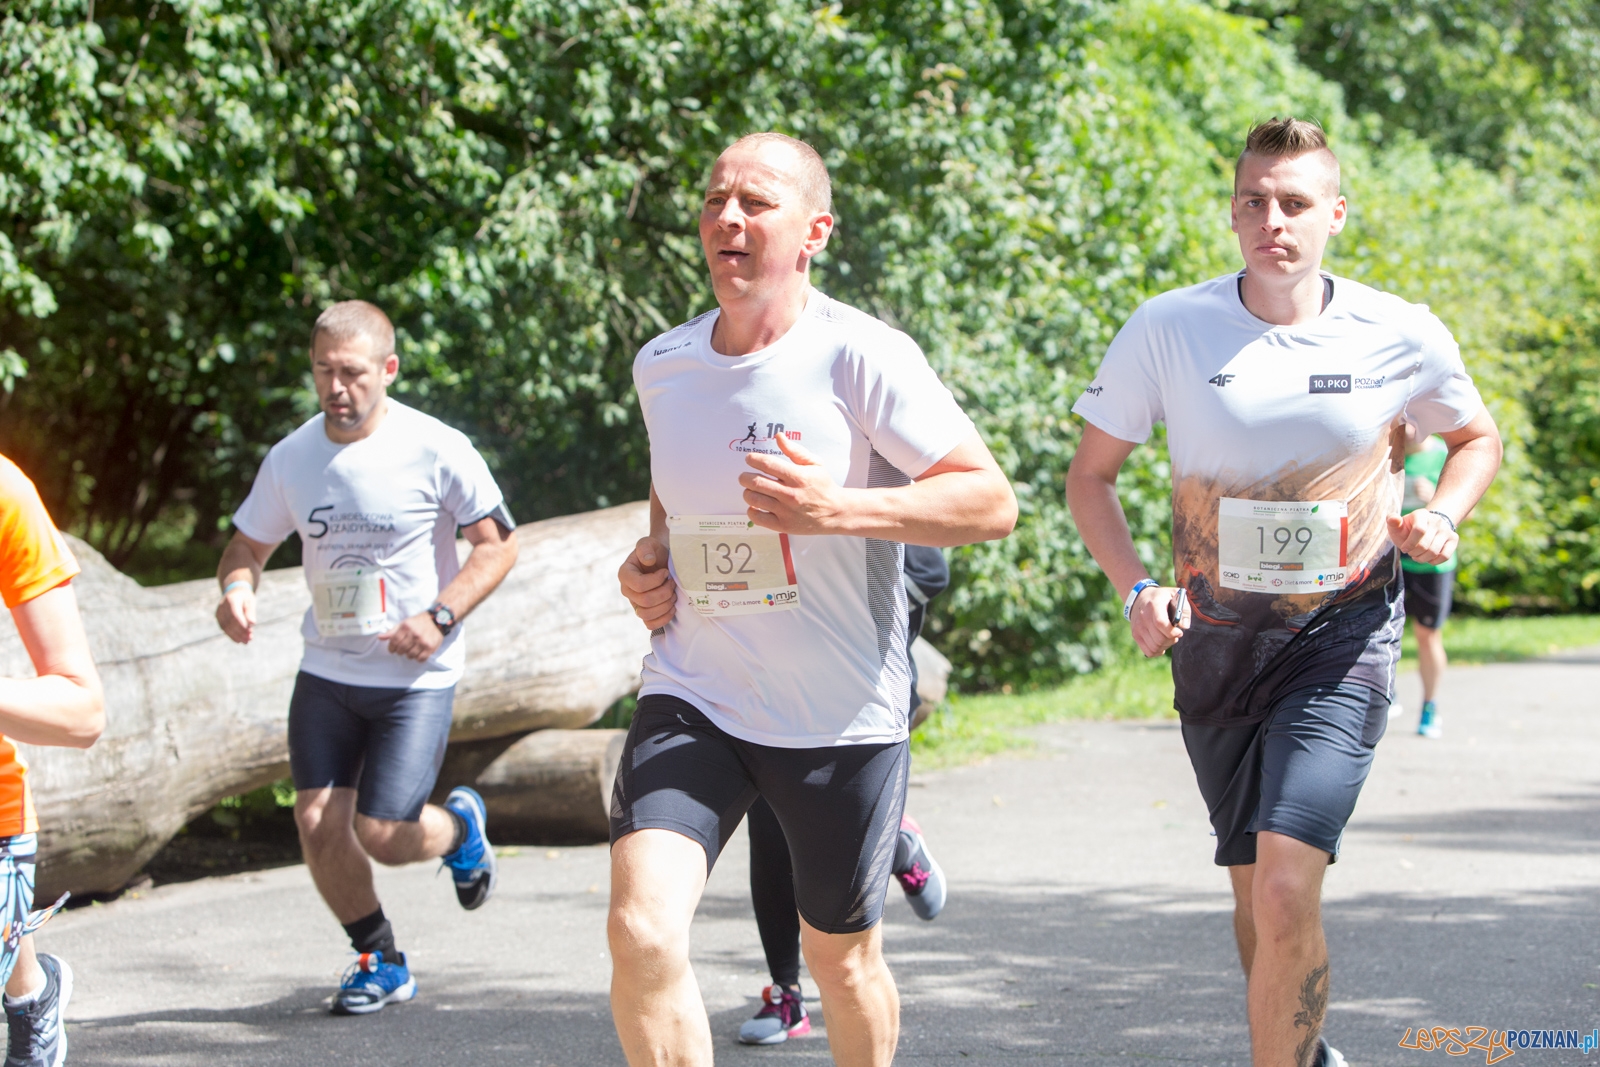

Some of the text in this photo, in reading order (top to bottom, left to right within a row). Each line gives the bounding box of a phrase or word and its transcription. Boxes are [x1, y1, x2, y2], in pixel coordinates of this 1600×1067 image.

[1209, 373, 1236, 387] 4F
[1313, 379, 1348, 389] 10. PKO
[766, 423, 785, 439] 10
[308, 505, 334, 539] 5
[1257, 526, 1312, 556] 199
[702, 543, 755, 574] 132
[1326, 572, 1344, 581] mjp
[327, 585, 359, 608] 177
[776, 590, 796, 600] mjp
